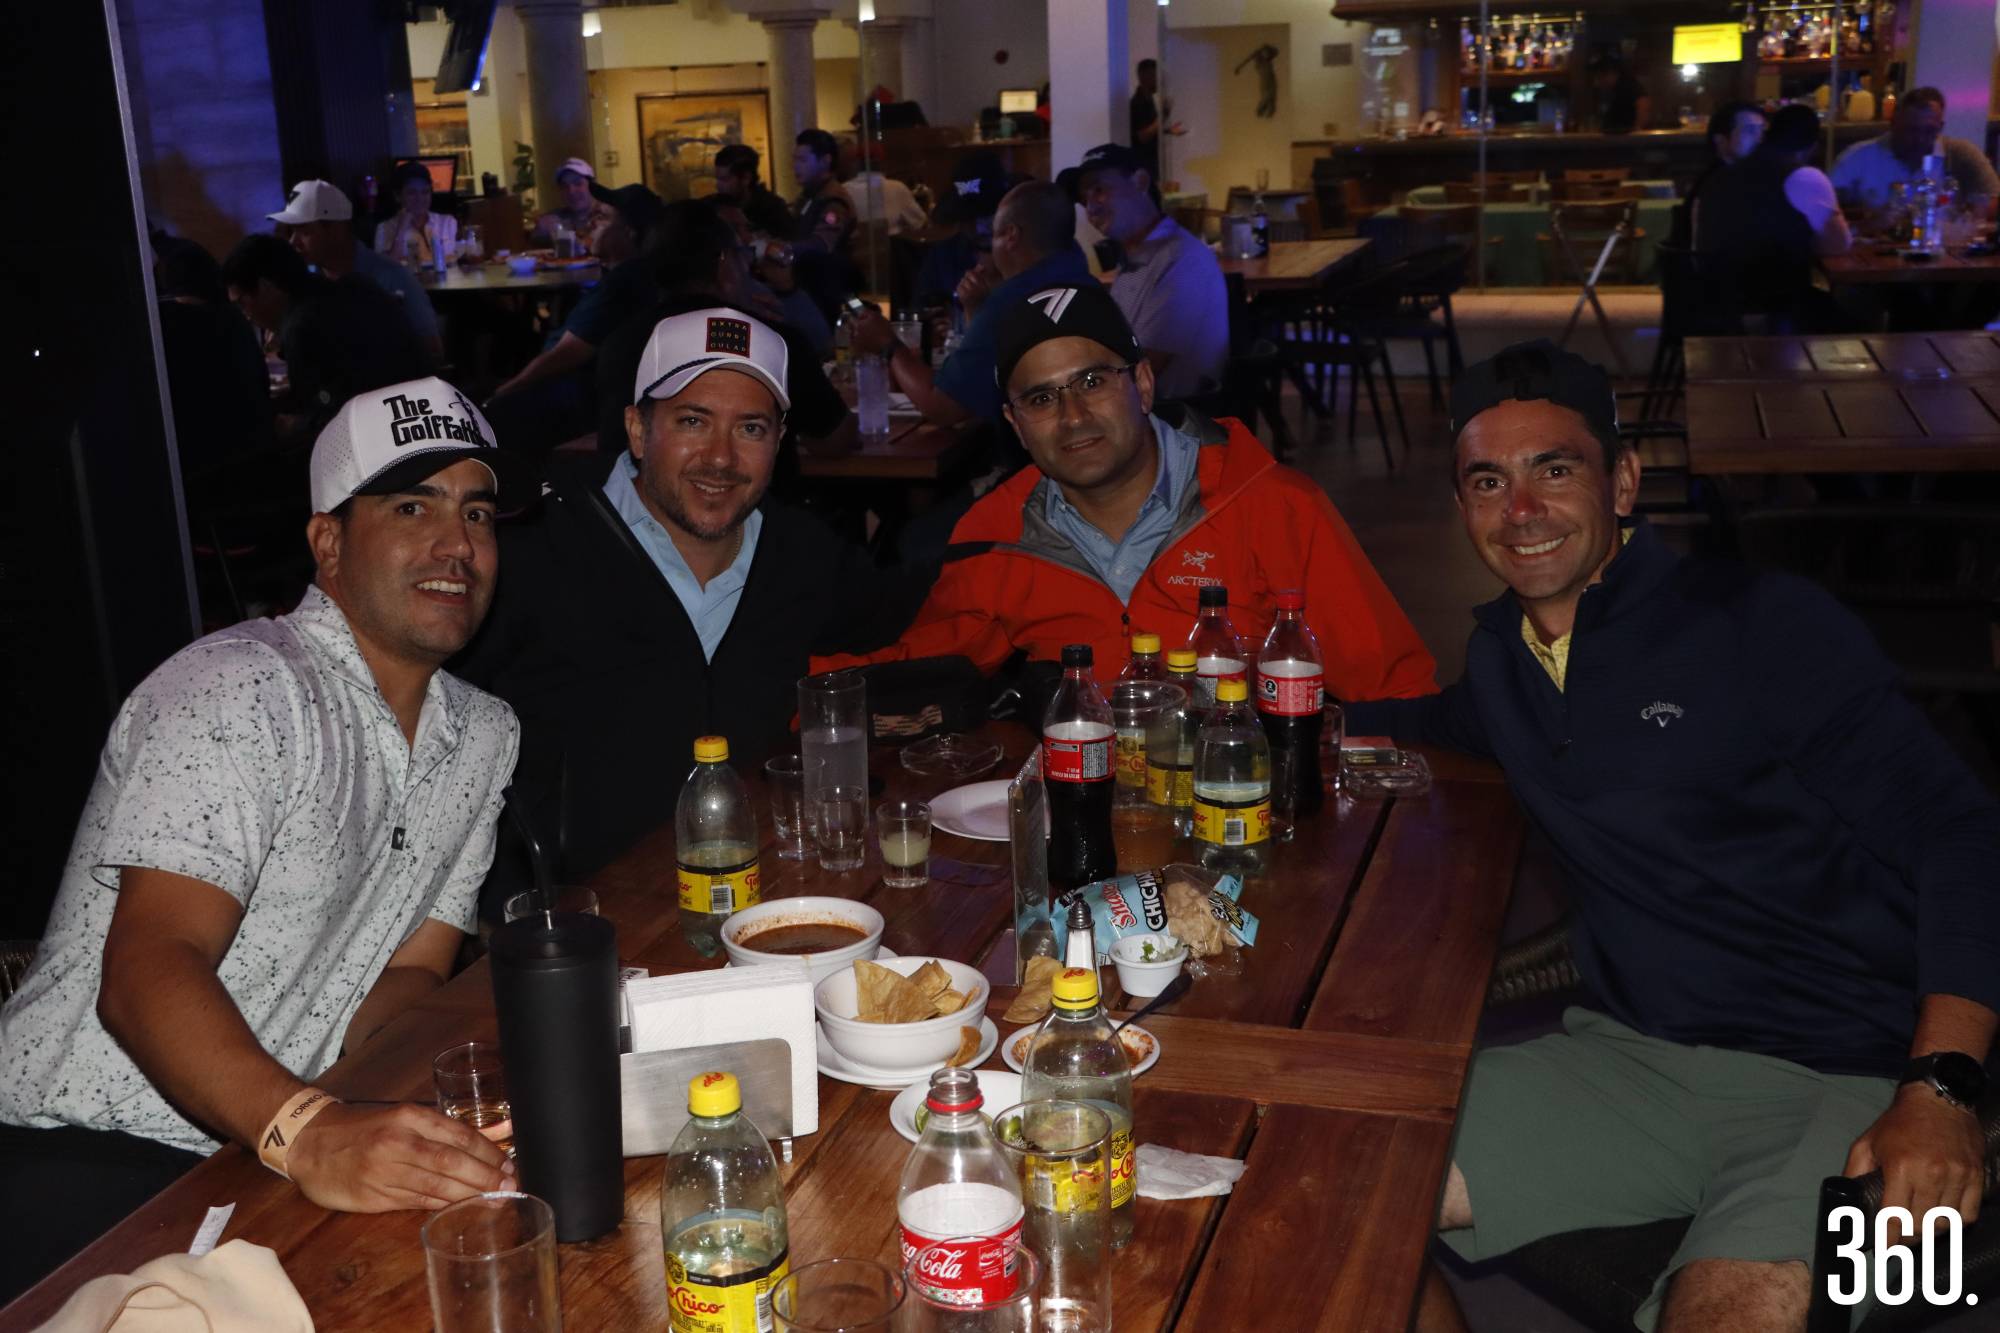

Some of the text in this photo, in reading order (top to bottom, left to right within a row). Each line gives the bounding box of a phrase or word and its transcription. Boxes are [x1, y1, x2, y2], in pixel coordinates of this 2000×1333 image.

[383, 394, 433, 420] The
[1640, 700, 1685, 720] Callaway
[675, 1286, 725, 1316] Chico
